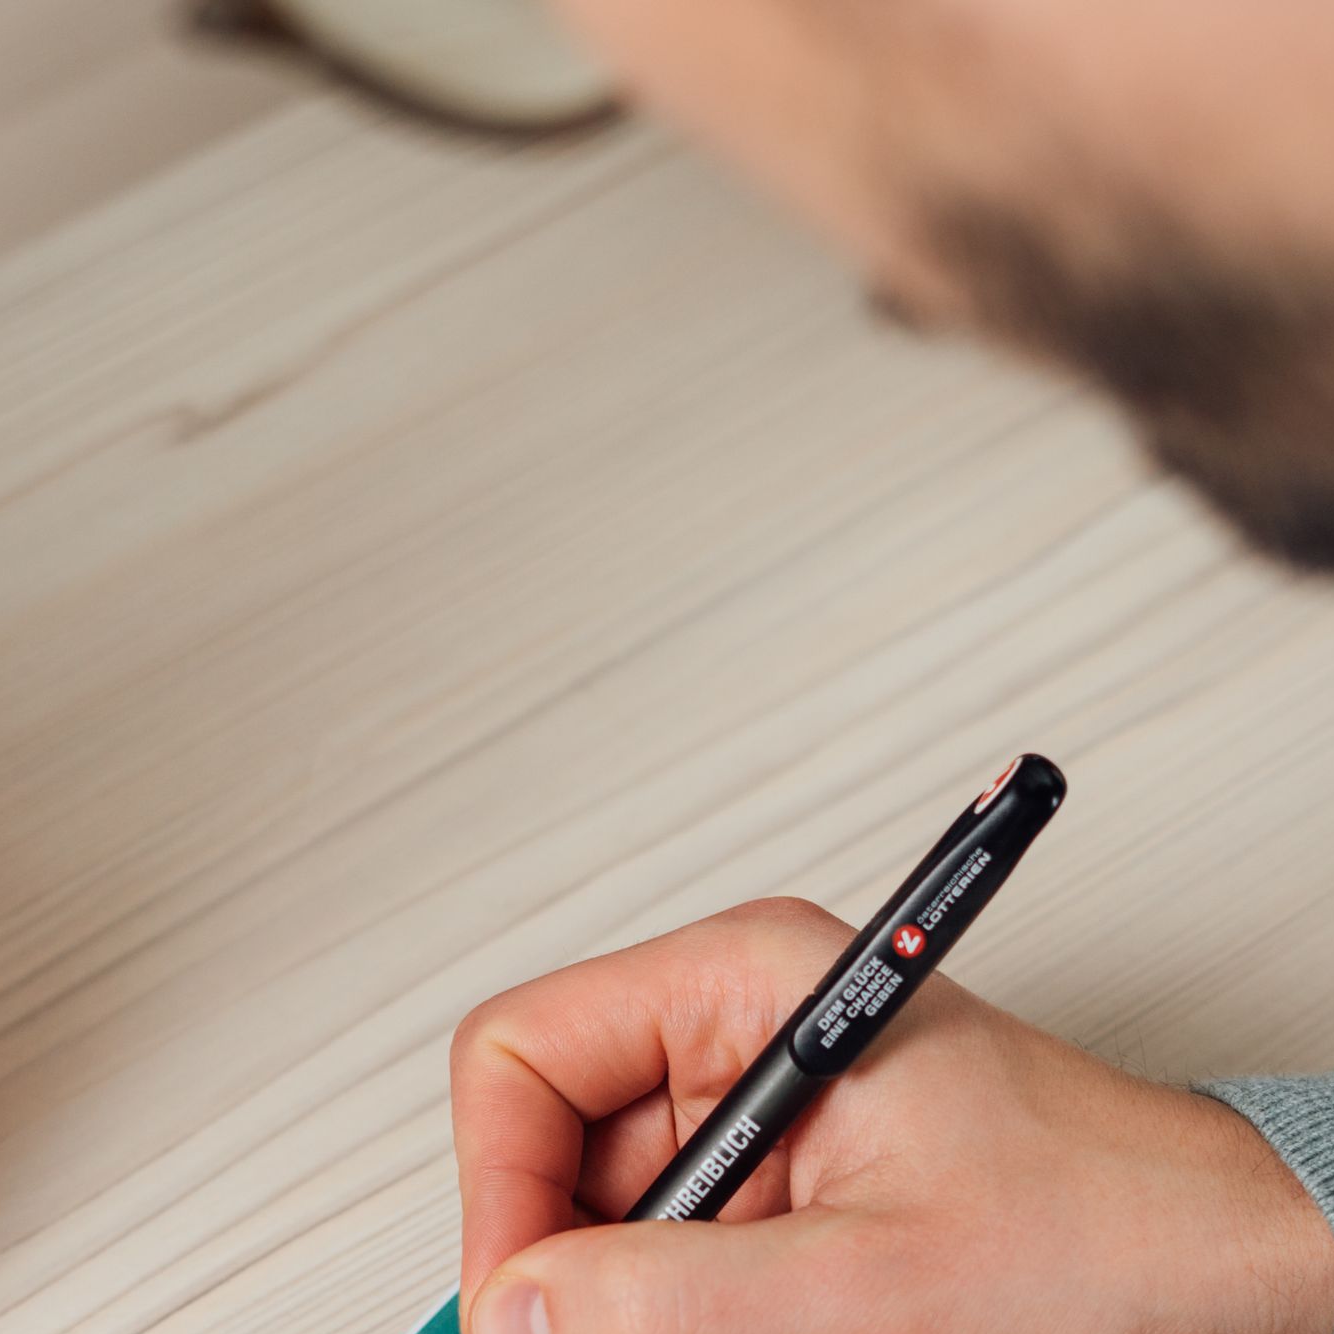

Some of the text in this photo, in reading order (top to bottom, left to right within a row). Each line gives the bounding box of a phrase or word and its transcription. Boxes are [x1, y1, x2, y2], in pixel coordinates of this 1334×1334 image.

[923, 851, 992, 931] LOTTERIEN
[817, 955, 883, 1032] DEM GLÜCK
[820, 964, 894, 1050] EINE CHANCE
[864, 973, 903, 1019] GEBEN
